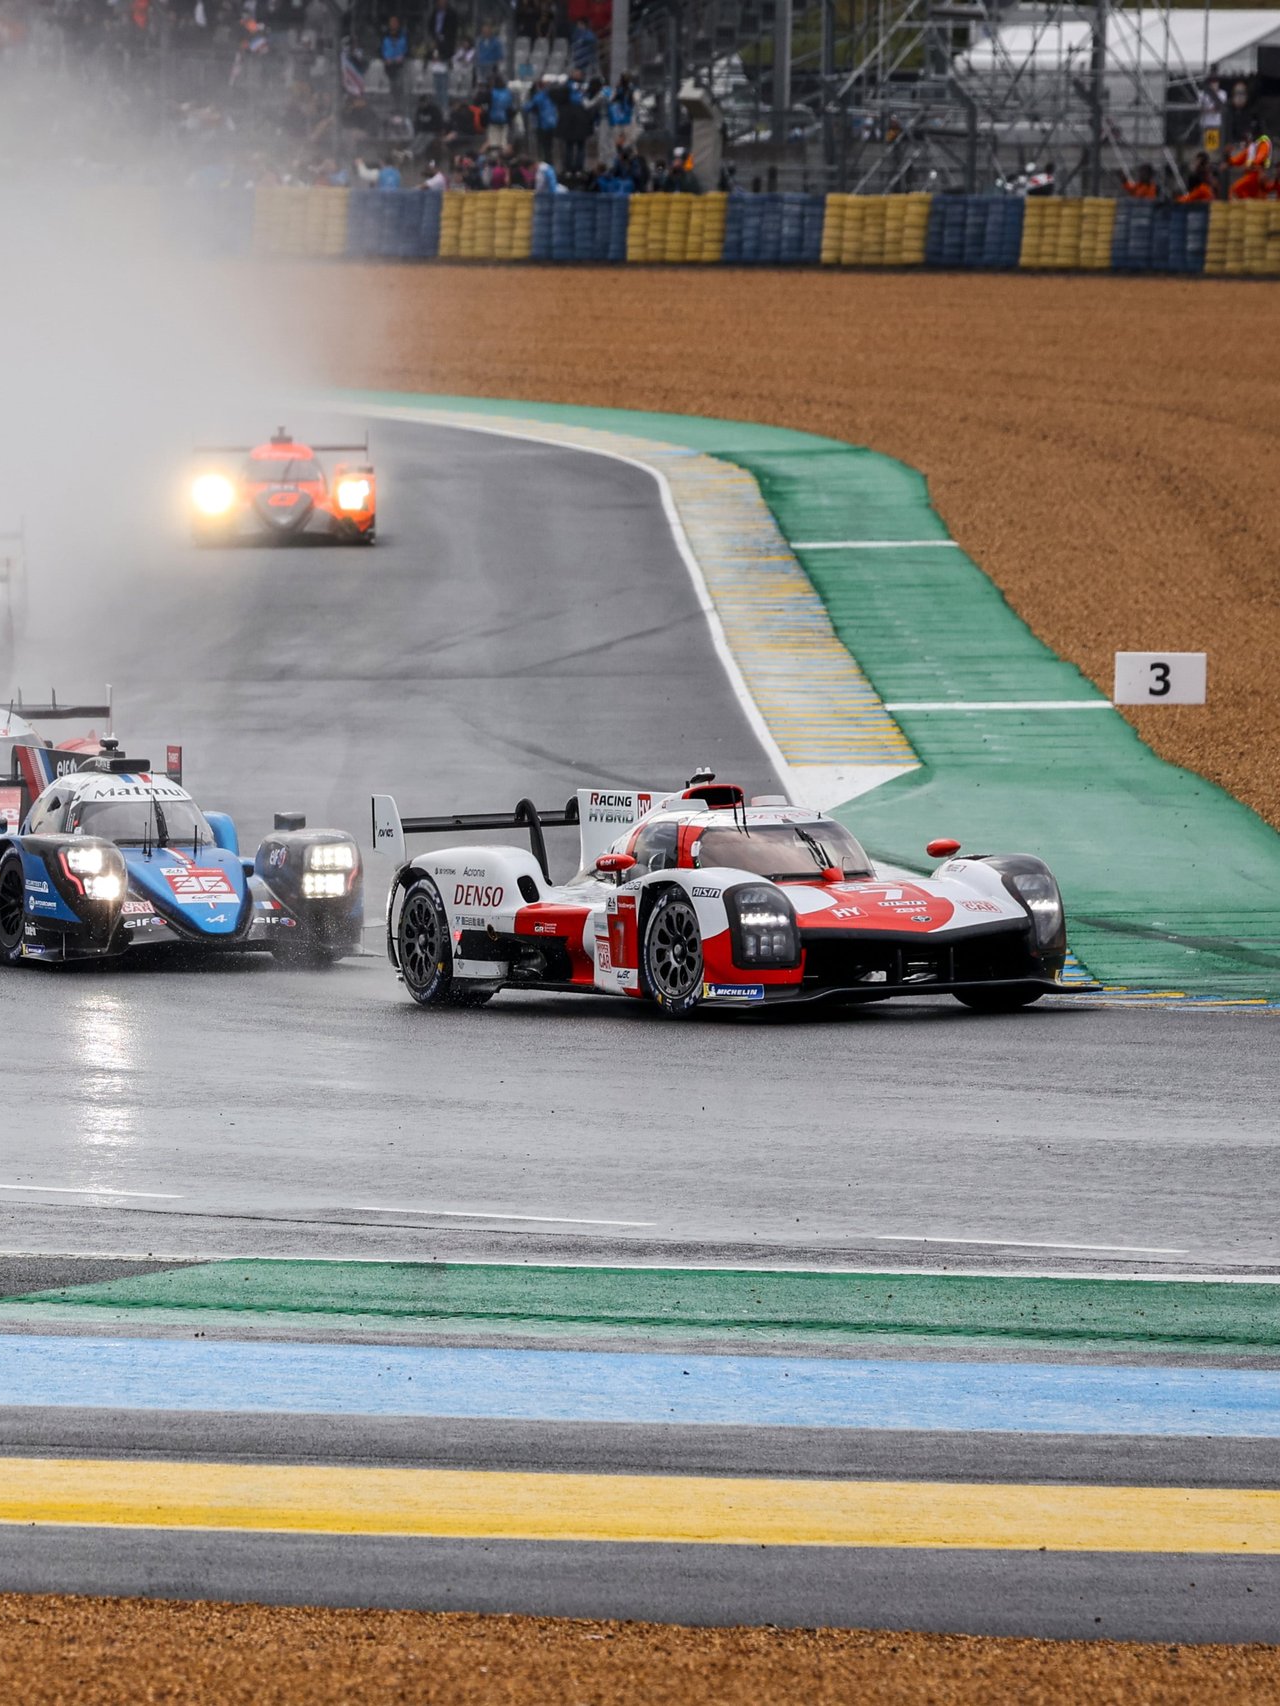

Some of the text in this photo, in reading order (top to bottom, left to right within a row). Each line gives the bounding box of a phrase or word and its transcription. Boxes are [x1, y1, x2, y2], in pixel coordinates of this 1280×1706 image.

[1149, 662, 1171, 696] 3
[590, 792, 632, 807] RACING
[589, 809, 634, 824] HYBRID
[463, 867, 486, 877] Acronis
[172, 876, 231, 892] 36
[454, 884, 504, 907] DENSO
[692, 887, 720, 898] AISIN
[859, 888, 903, 901] 7
[831, 906, 861, 918] HY
[966, 903, 998, 912] CAR
[123, 918, 150, 928] elf
[253, 916, 279, 924] elf
[599, 953, 611, 971] CAR
[716, 988, 758, 996] MICHELIN
